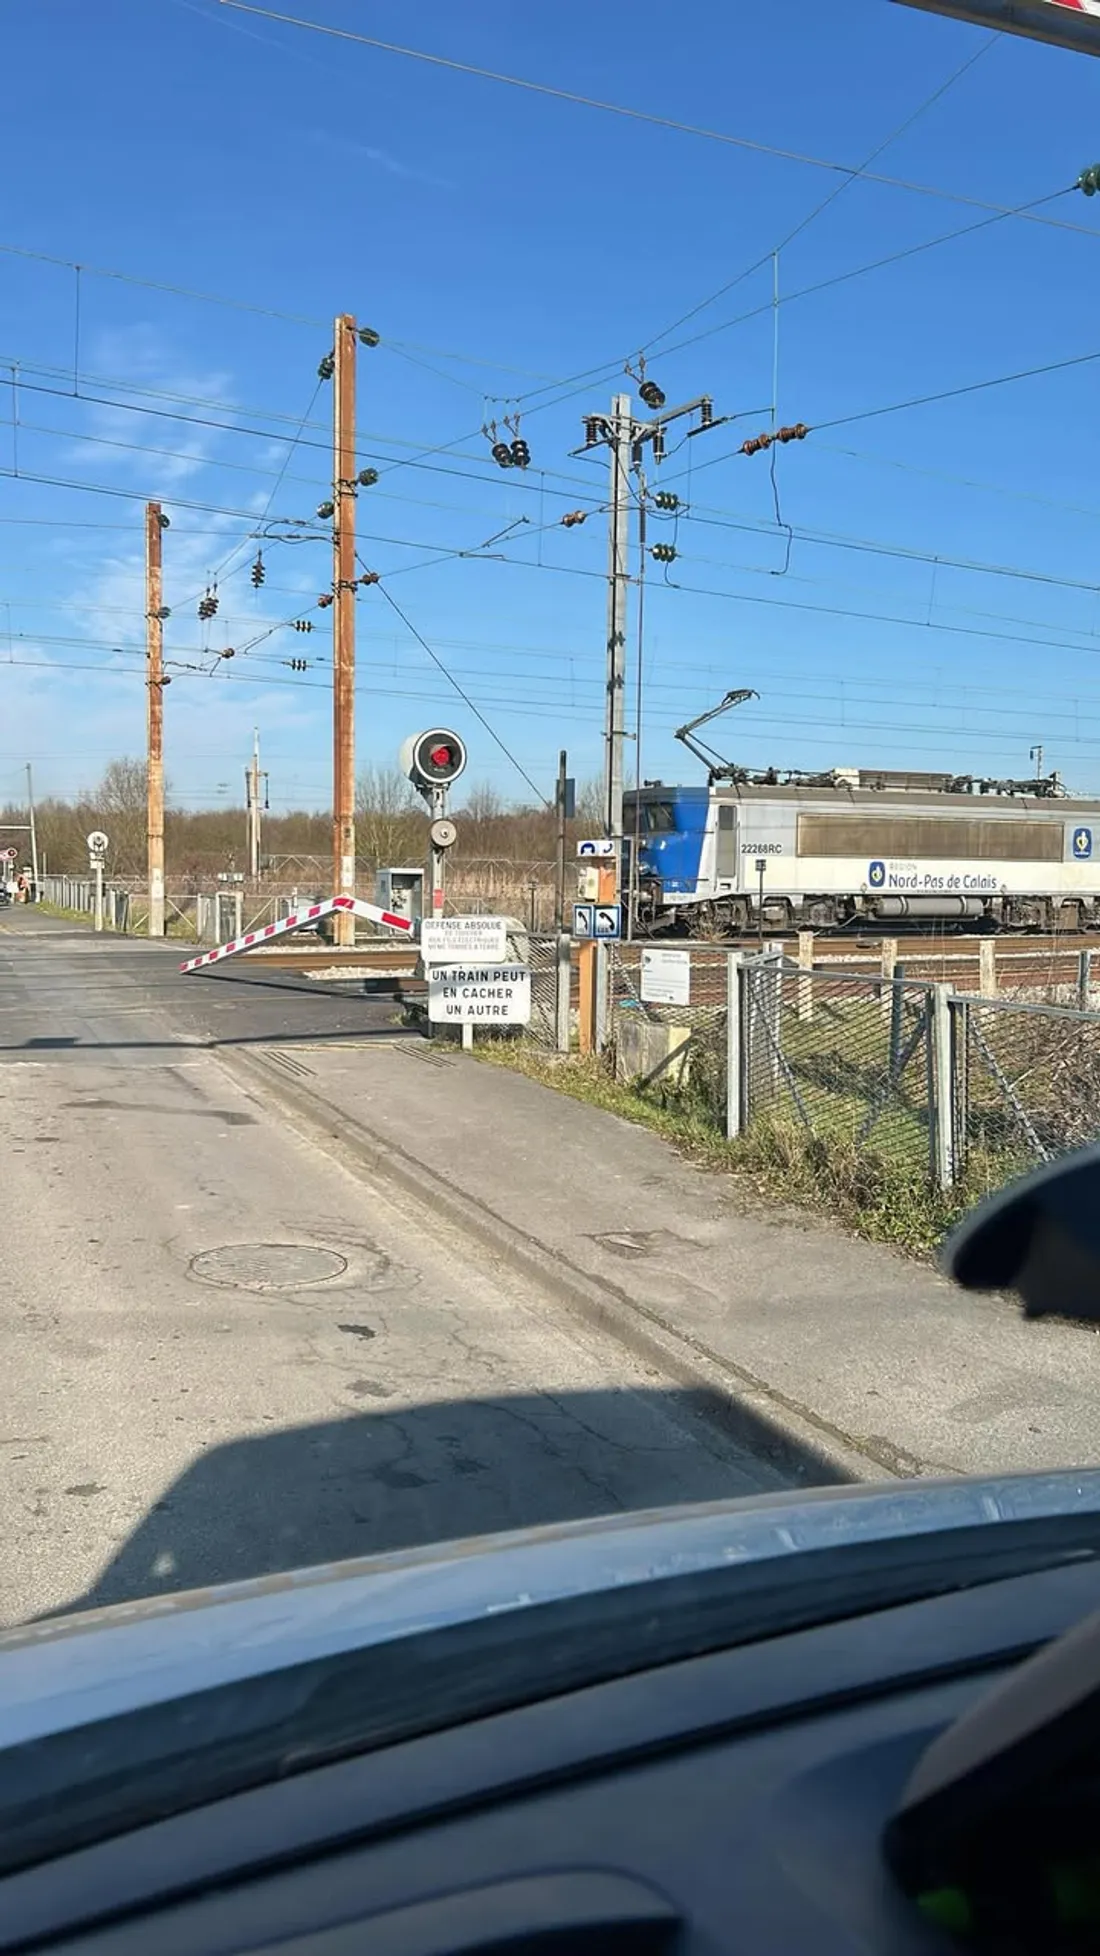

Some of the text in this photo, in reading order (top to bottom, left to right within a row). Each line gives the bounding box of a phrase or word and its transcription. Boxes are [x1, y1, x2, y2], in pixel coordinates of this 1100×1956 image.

[889, 873, 997, 889] Nord-Pas de Calais
[464, 921, 502, 930] ABSOLUE
[432, 970, 526, 982] UN TRAIN PEUT
[443, 987, 513, 998] EN CACHER
[446, 1004, 509, 1016] UN AUTRE
